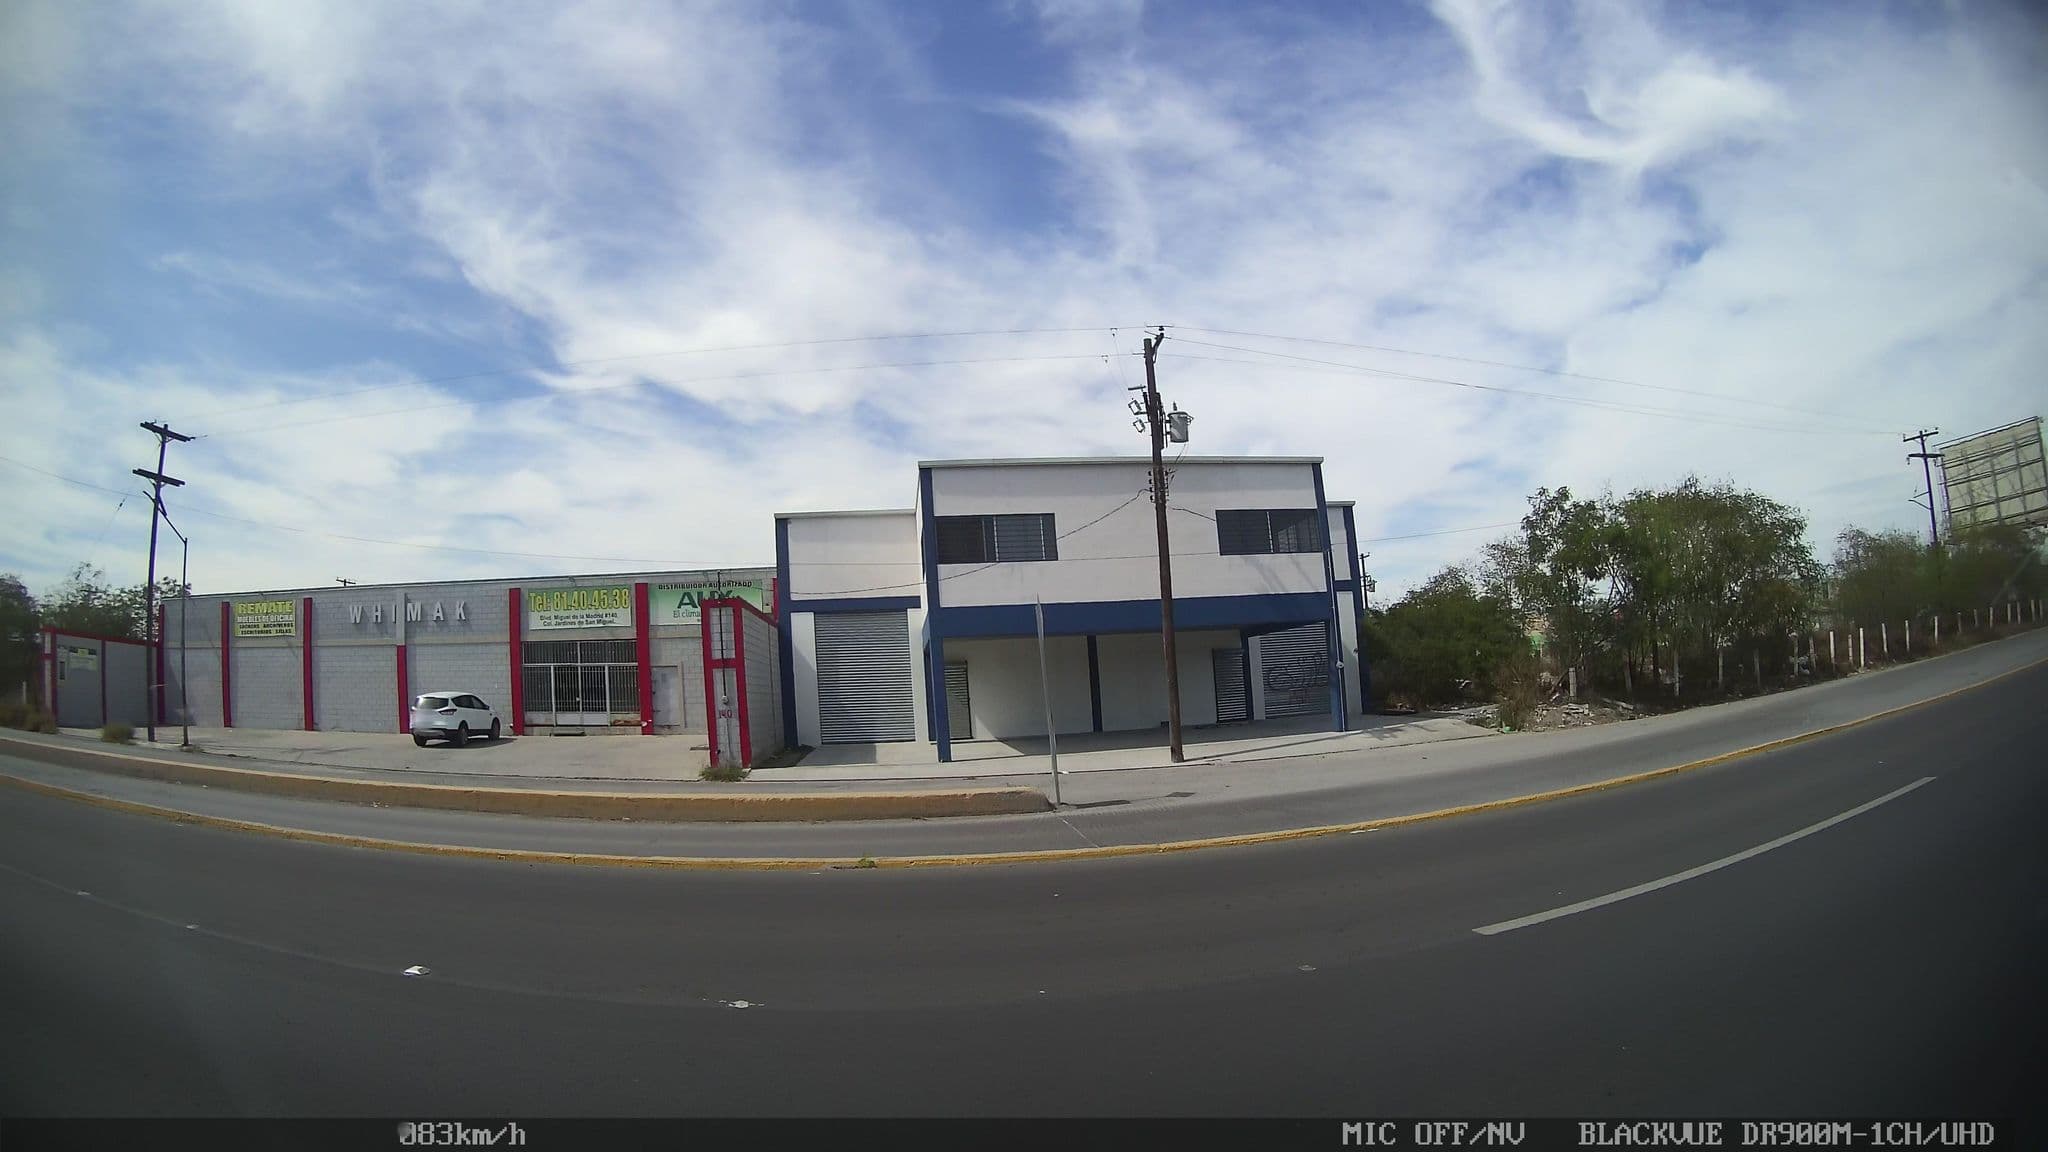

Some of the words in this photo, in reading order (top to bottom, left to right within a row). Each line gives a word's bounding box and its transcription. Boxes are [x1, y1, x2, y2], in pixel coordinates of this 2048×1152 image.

[238, 601, 293, 614] REMATE
[529, 592, 551, 612] Tel:
[554, 589, 629, 611] 81.40.45.38
